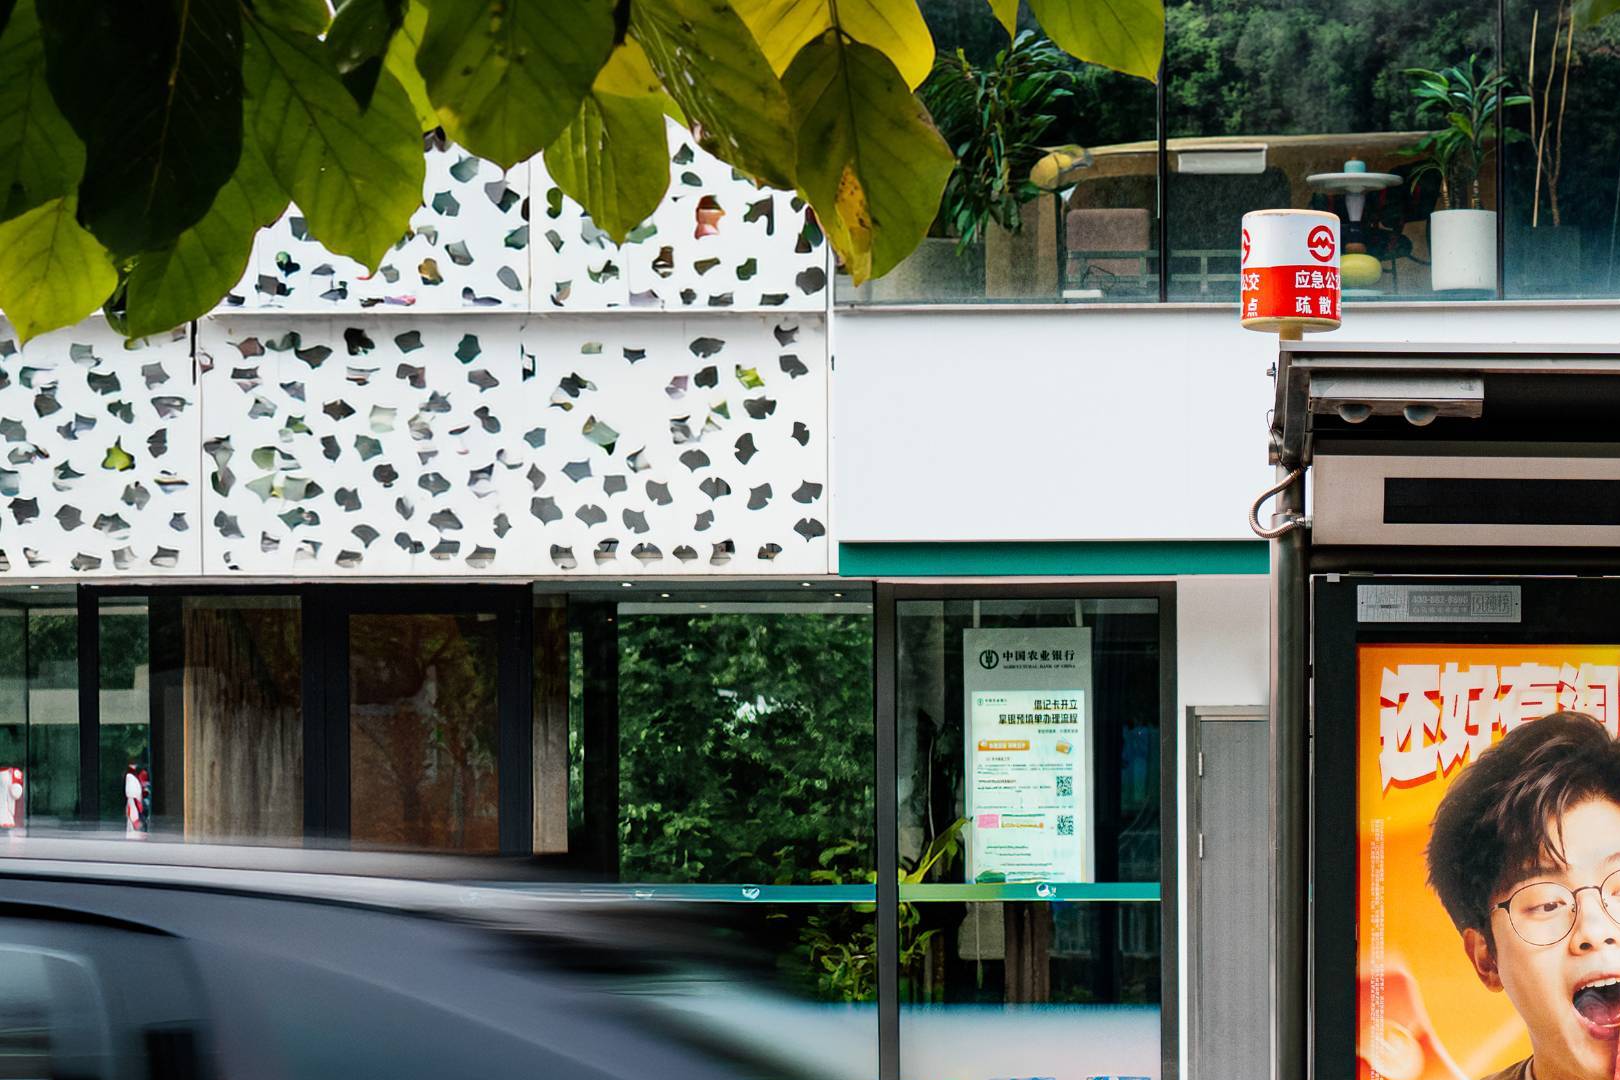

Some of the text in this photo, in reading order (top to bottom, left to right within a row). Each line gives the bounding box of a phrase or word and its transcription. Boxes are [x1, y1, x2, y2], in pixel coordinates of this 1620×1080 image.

[1003, 650, 1075, 662] 中国农业银行
